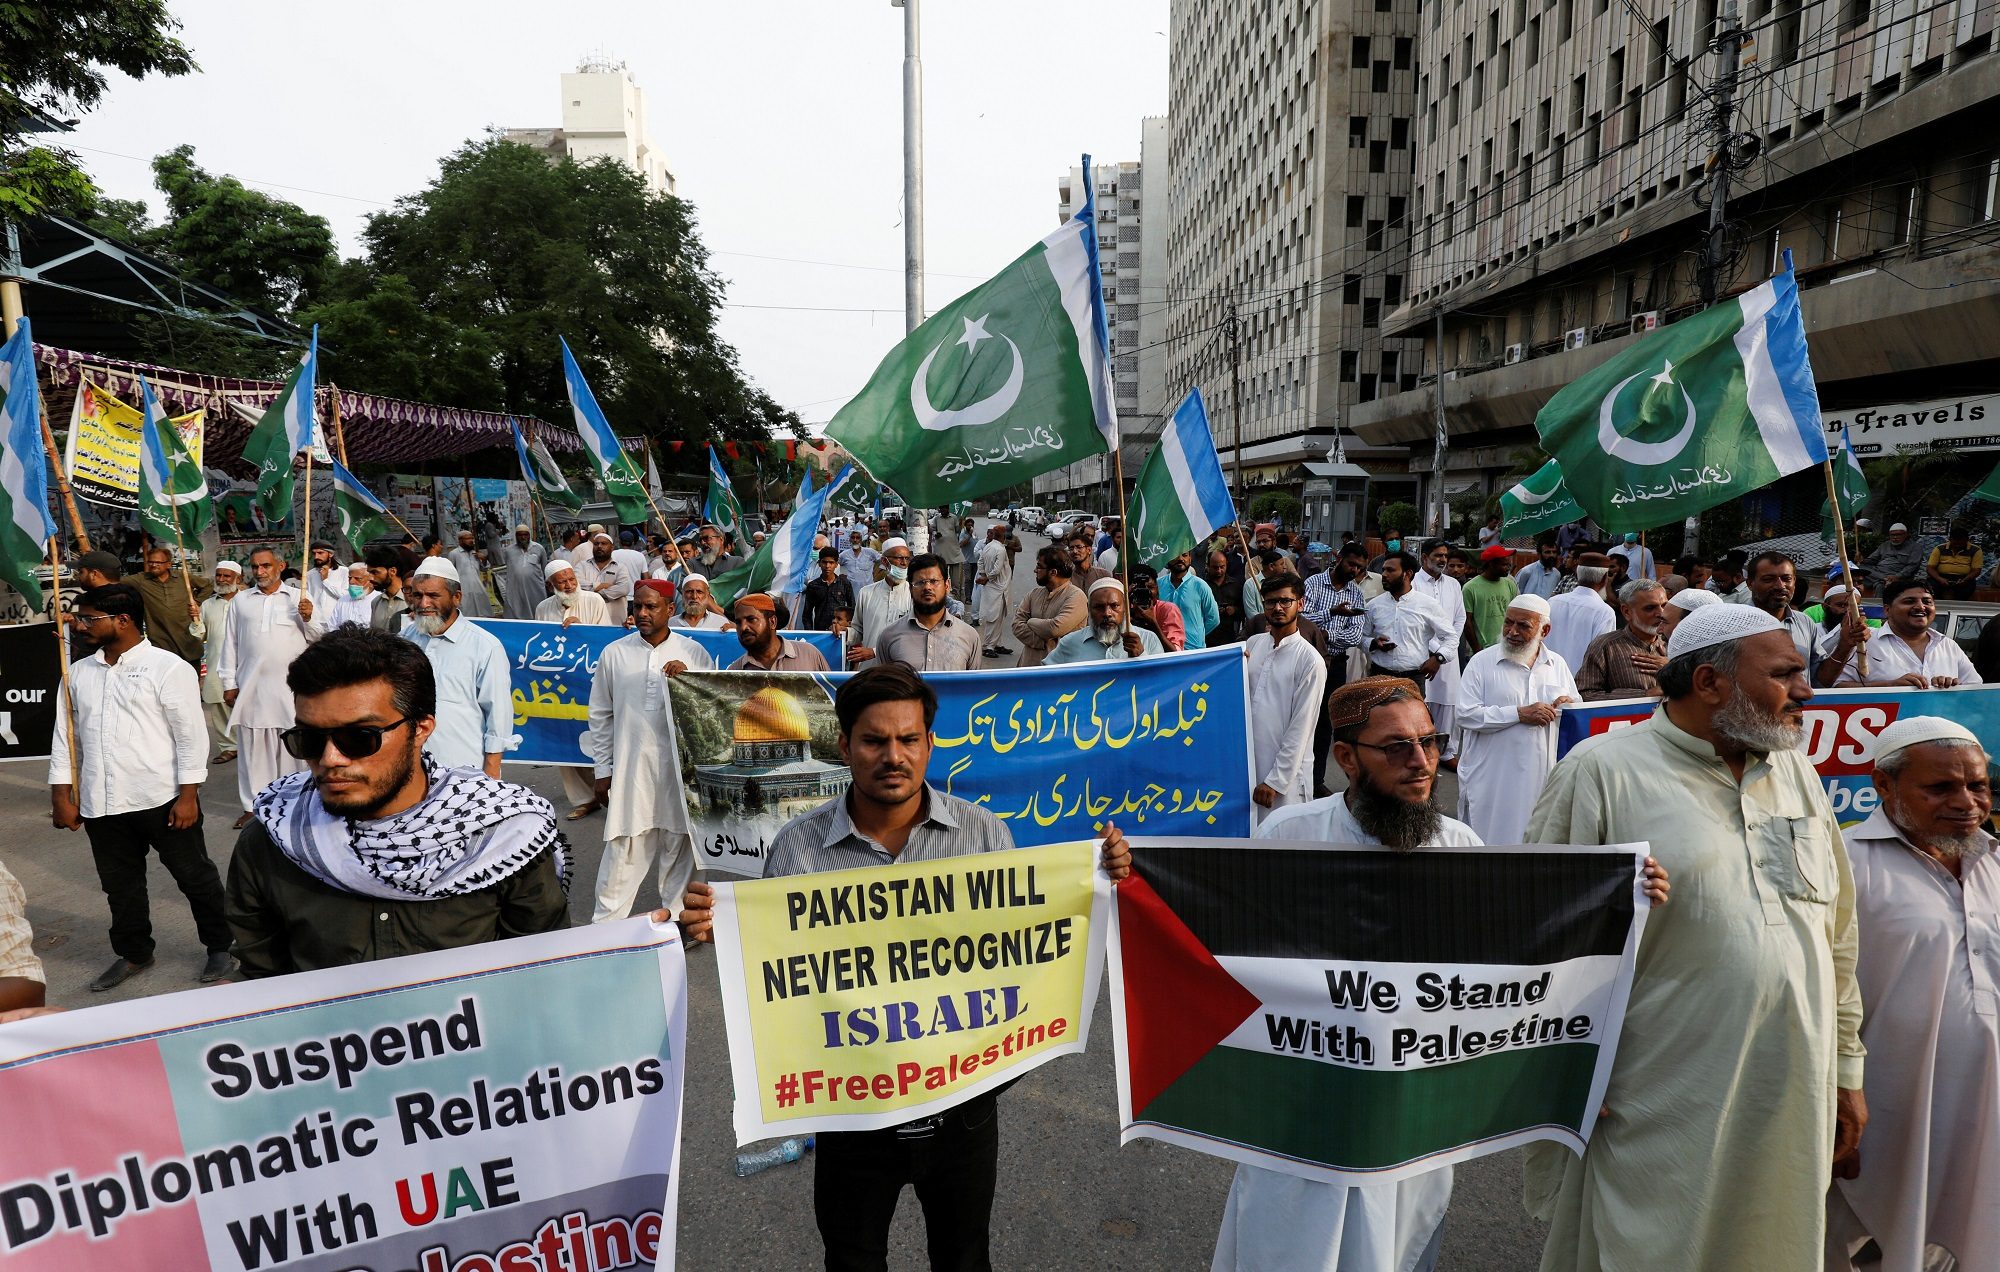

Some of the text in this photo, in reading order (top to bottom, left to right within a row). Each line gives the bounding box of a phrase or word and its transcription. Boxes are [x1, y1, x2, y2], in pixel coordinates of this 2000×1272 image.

[1855, 402, 1985, 434] Travels
[6, 689, 46, 703] our
[933, 678, 1210, 753] قبلہ اول کی آزادی تک
[1033, 773, 1112, 832] جاری
[704, 833, 764, 859] اسلامی
[786, 865, 1046, 931] PAKISTAN WILL
[762, 918, 1072, 1002] NEVER RECOGNIZE
[1325, 970, 1554, 1012] We Stand
[205, 997, 482, 1099] Suspend
[820, 985, 1029, 1048] ISRAEL
[1264, 1011, 1593, 1067] With Palestine
[774, 1017, 1068, 1109] #FreePalestine
[0, 1058, 665, 1249] Diplomatic Relations
[226, 1156, 521, 1271] With UAE
